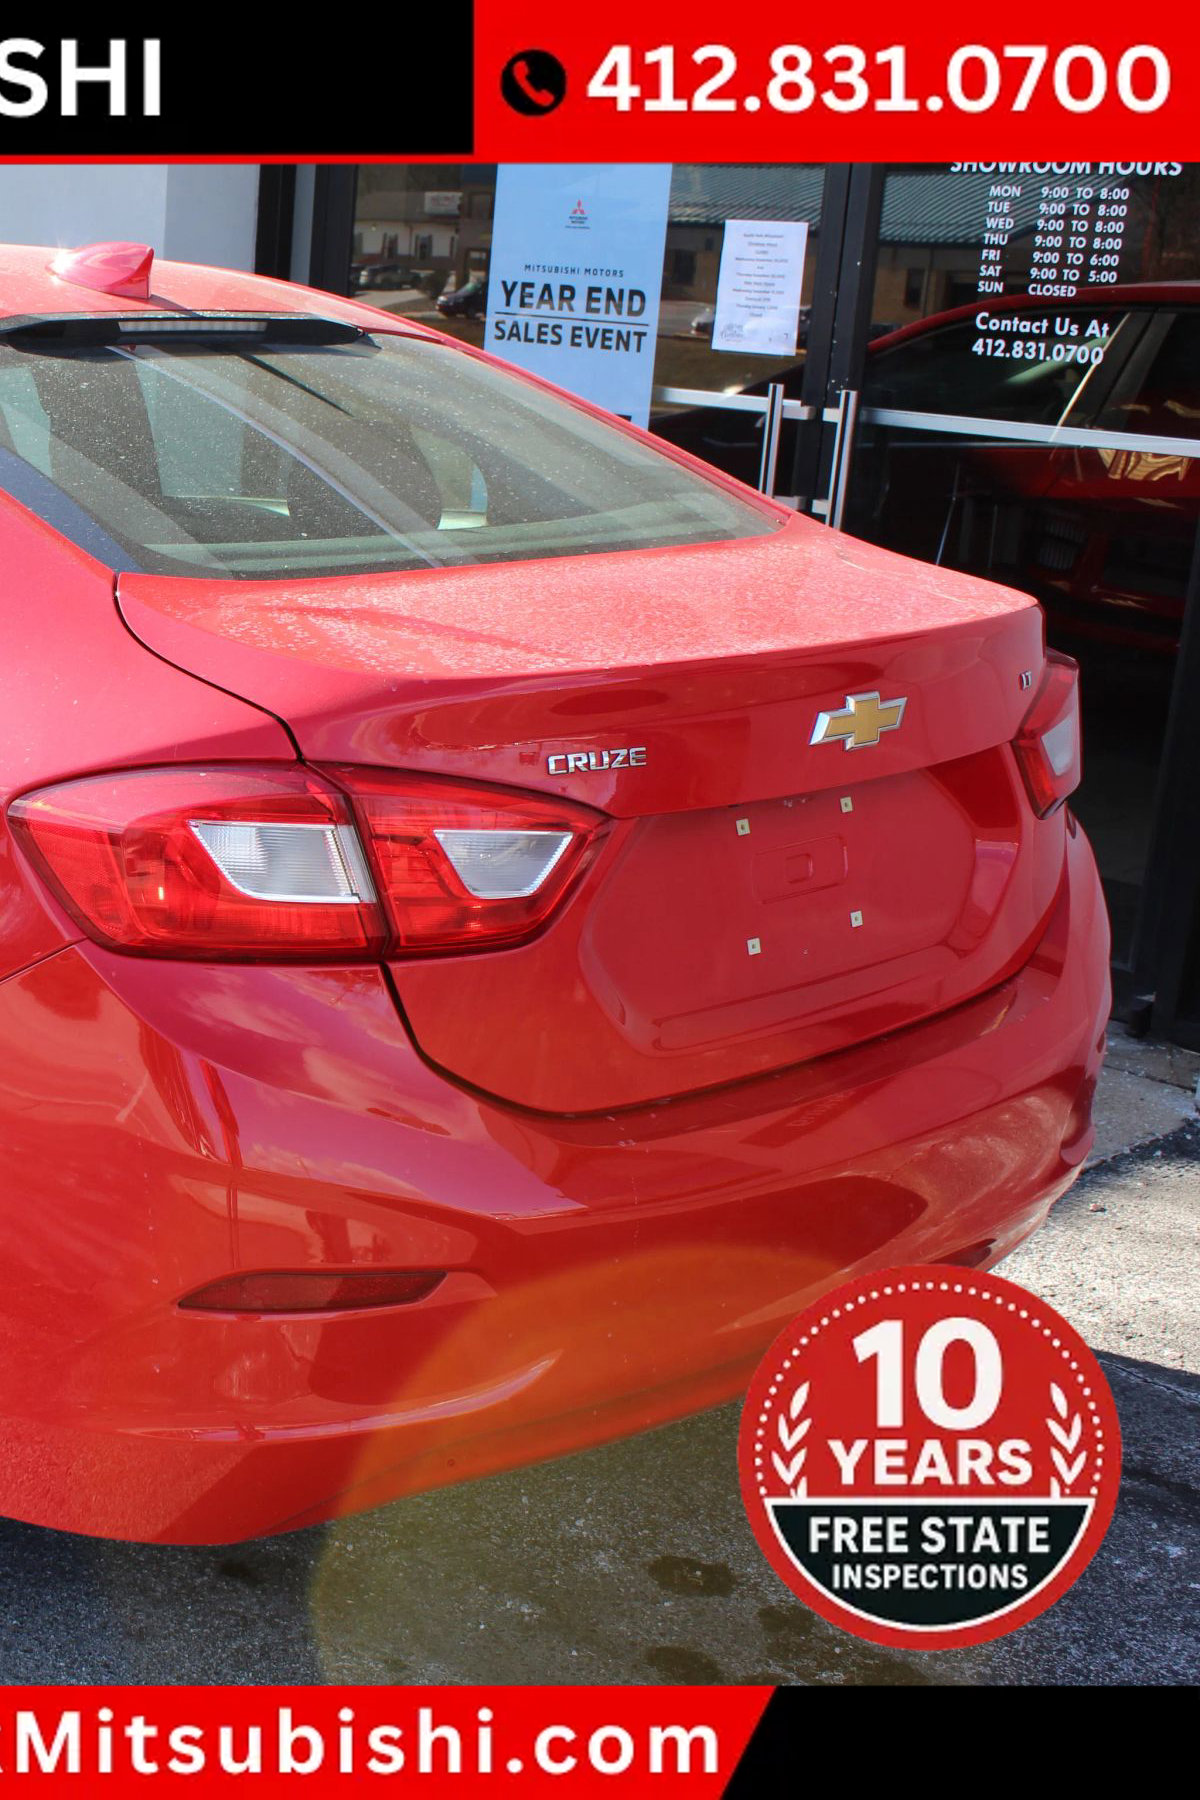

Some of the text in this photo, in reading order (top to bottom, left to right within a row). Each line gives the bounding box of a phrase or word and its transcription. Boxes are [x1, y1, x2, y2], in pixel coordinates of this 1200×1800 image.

[950, 162, 1183, 176] SHOWROOM HOURS
[989, 185, 1130, 201] MON 9:00 TO 8:00
[987, 201, 1128, 218] TUE 9:00 TO 8:00
[985, 217, 1125, 235] WED 9:00 TO 8:00
[983, 233, 1123, 251] THU 9:00 TO 8:00
[981, 249, 1120, 267] FRI 9:00 TO 6:00
[524, 264, 625, 278] MITSUBISHI MOTORS
[979, 265, 1118, 284] SAT 9:00 TO 5:00
[501, 280, 647, 317] YEAR END
[977, 281, 1077, 298] SUN CLOSED
[975, 311, 1110, 338] Contact Us At
[494, 320, 648, 353] SALES EVENT
[971, 337, 1105, 366] 412.831.0700
[547, 746, 648, 775] CRUZE
